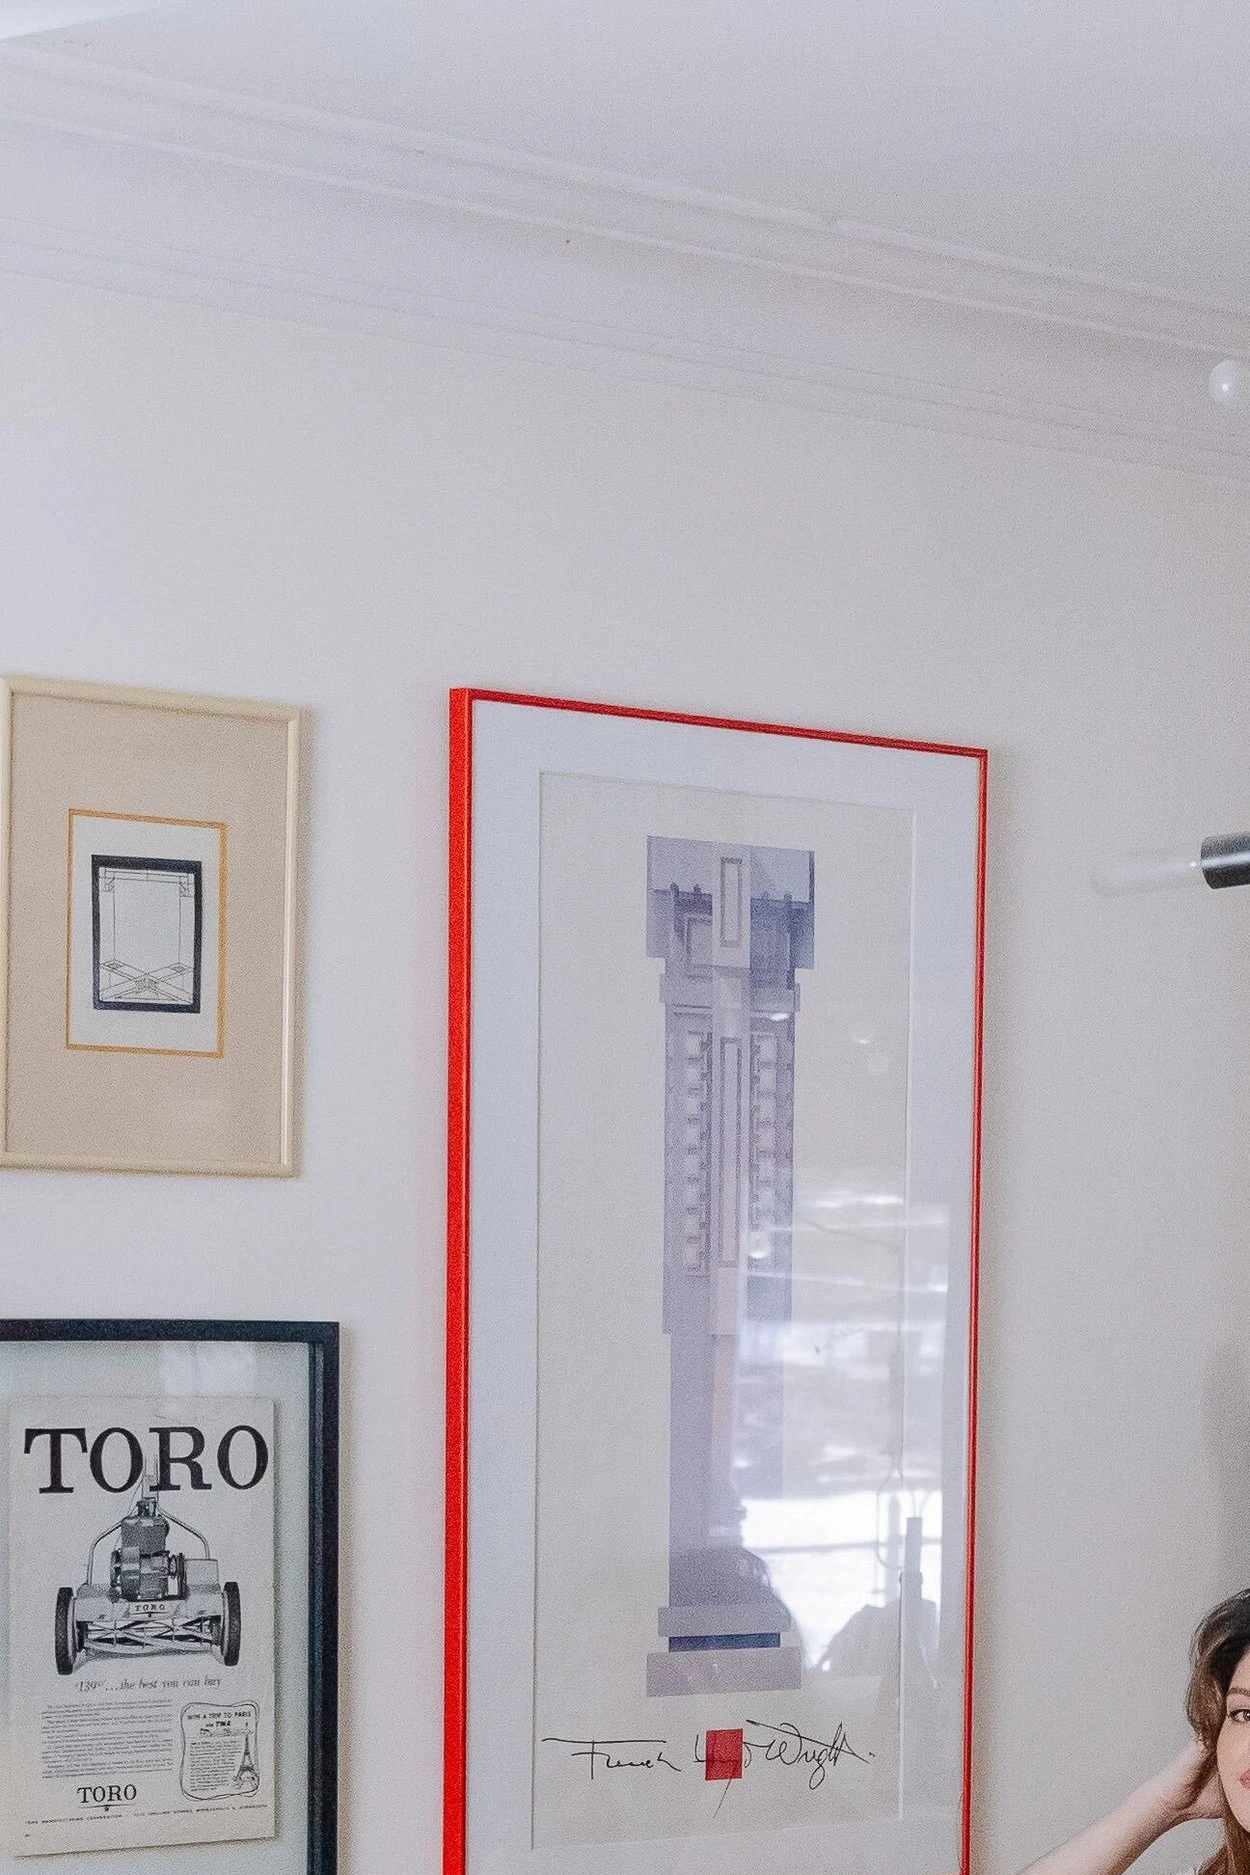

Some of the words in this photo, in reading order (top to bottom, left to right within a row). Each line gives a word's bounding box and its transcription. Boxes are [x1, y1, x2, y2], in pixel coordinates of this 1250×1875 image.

[24, 1424, 269, 1494] TORO
[134, 1603, 166, 1612] TORO
[77, 1784, 137, 1803] TORO
